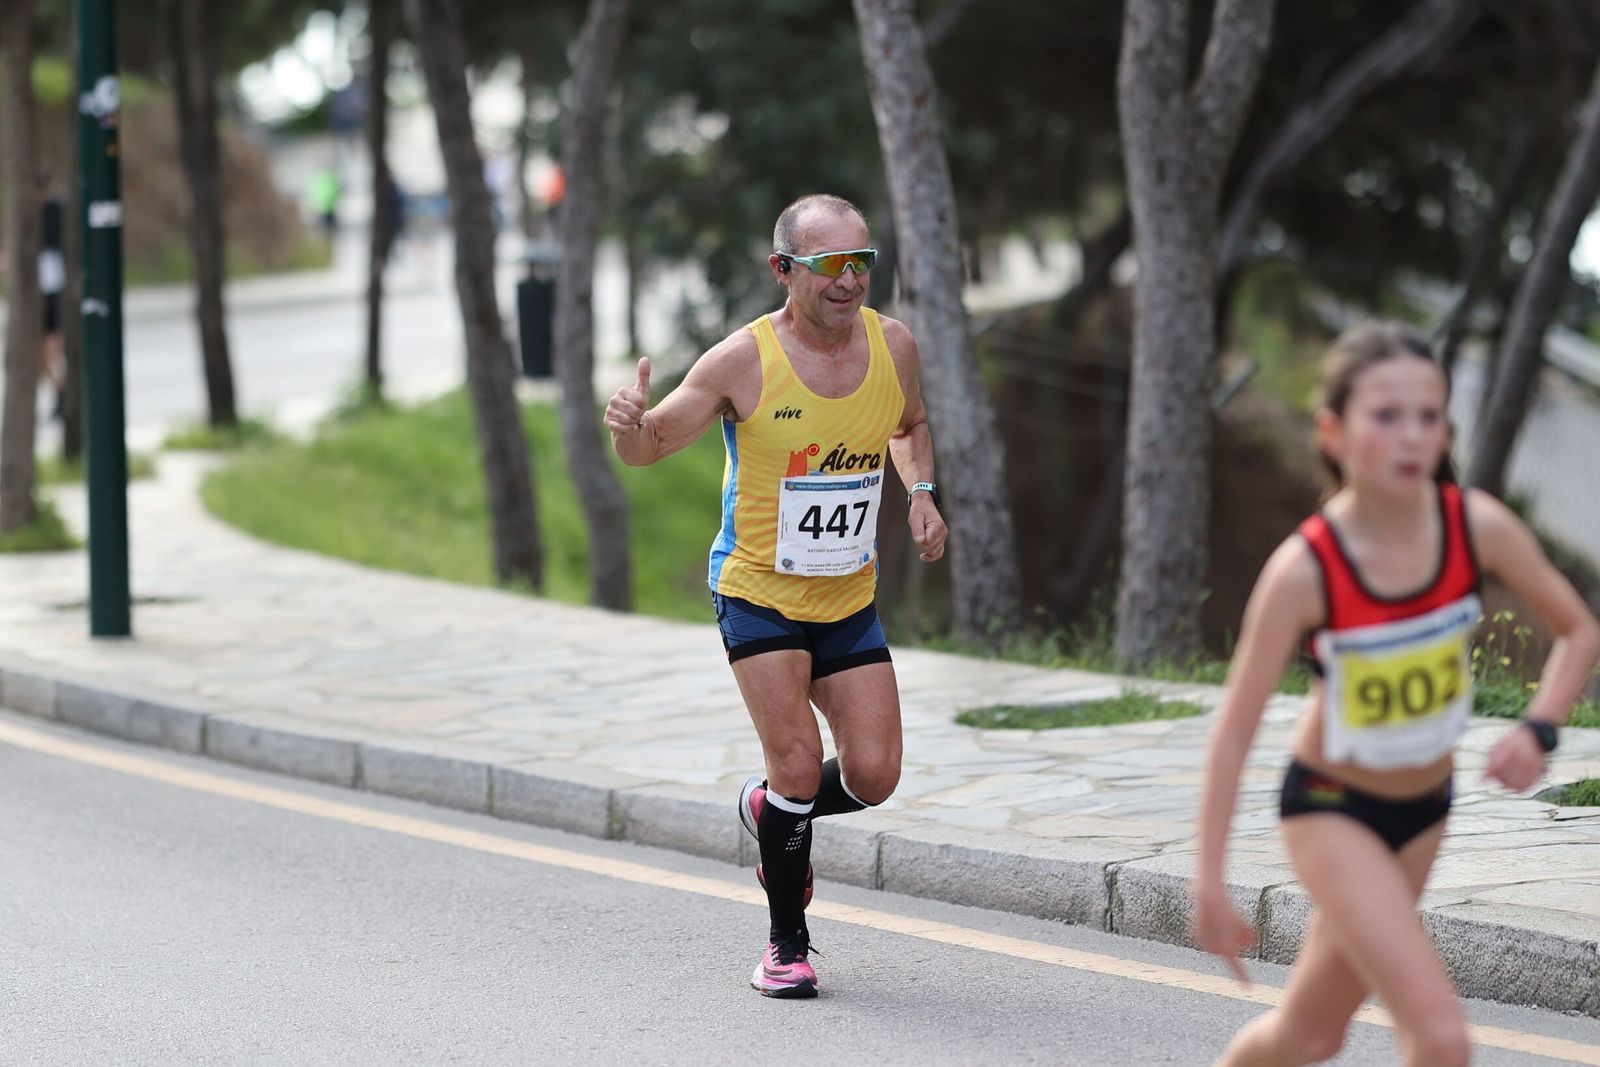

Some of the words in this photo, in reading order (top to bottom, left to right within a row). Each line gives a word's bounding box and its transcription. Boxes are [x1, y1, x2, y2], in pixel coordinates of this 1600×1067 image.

[819, 442, 881, 472] Álora
[798, 500, 870, 540] 447
[1357, 654, 1458, 724] 902
